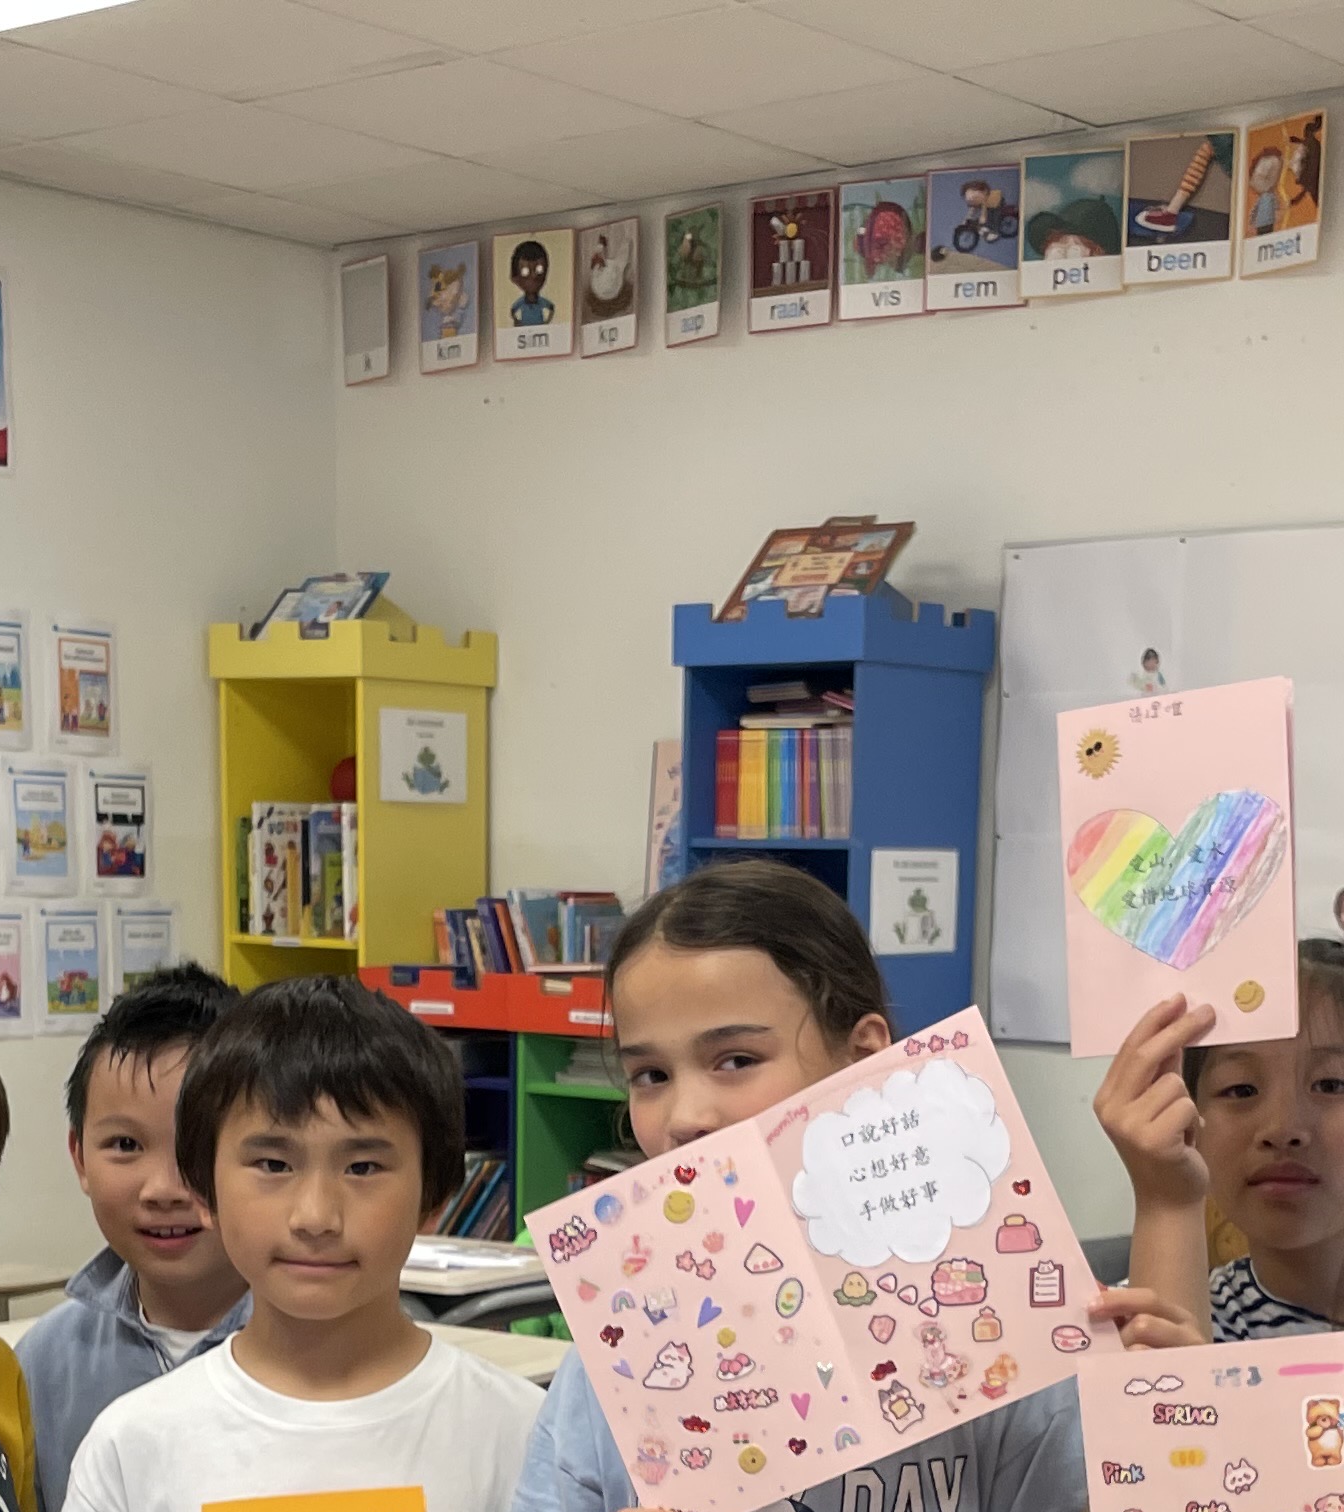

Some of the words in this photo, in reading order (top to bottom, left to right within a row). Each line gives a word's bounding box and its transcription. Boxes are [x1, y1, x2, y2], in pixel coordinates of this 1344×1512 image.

[1147, 247, 1207, 274] been
[1258, 233, 1301, 264] meet
[953, 273, 999, 299] rem
[1053, 262, 1090, 289] pet
[769, 296, 809, 320] raak
[871, 283, 901, 306] vis
[841, 1109, 920, 1148] 口說好話
[849, 1145, 931, 1183] 心想好意
[859, 1180, 940, 1222] 手做好事
[1152, 1402, 1218, 1426] SPRING
[1101, 1460, 1146, 1485] Pink
